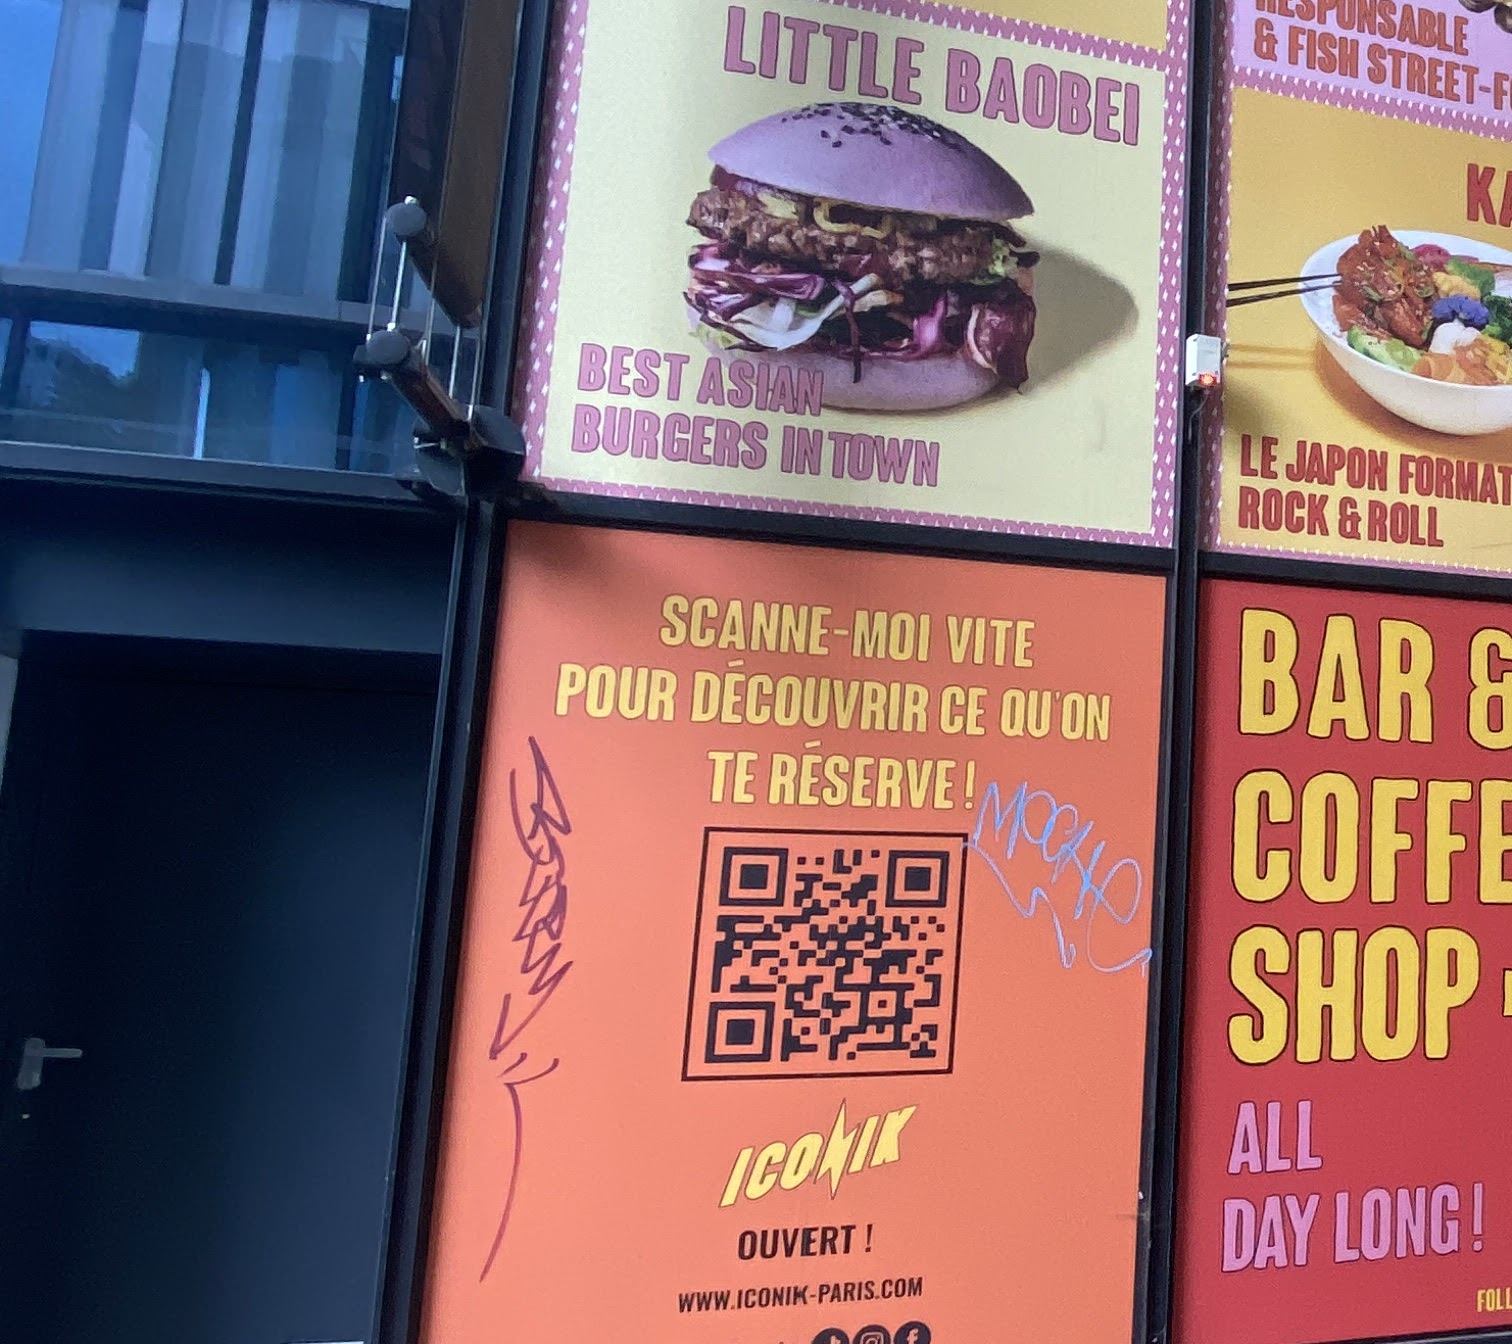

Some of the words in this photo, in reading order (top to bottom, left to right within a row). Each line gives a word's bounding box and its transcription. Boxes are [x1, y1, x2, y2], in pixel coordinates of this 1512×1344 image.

[723, 6, 924, 104] LITTLE
[946, 48, 1139, 146] BAOBEI
[1254, 17, 1277, 61] &
[1288, 28, 1359, 79] FISH
[578, 343, 690, 404] BEST
[697, 356, 824, 416] ASIAN
[571, 405, 768, 469] BURGERS
[781, 426, 822, 477] IN
[827, 429, 939, 487] TOWN
[1241, 434, 1278, 478] LE
[1285, 440, 1388, 492] JAPON
[1238, 486, 1329, 537] ROCK
[1338, 498, 1362, 541] &
[1368, 500, 1444, 548] ROLL
[660, 594, 931, 663] SCANNE-MOI
[947, 616, 1036, 668] VITE
[555, 663, 678, 721] POUR
[691, 659, 928, 732] DÉCOUVRIR
[939, 685, 987, 736] CE
[1001, 686, 1111, 741] QU'ON
[1238, 607, 1435, 743] BAR
[708, 750, 756, 803] TE
[1228, 924, 1480, 1066] SHOP
[718, 1098, 918, 1208] ICONIK
[1228, 1100, 1323, 1174] ALL
[738, 1224, 857, 1261] OUVERT
[1221, 1192, 1320, 1273] DAY
[678, 1277, 924, 1314] WWW.ICONIK-PARIS.COM
